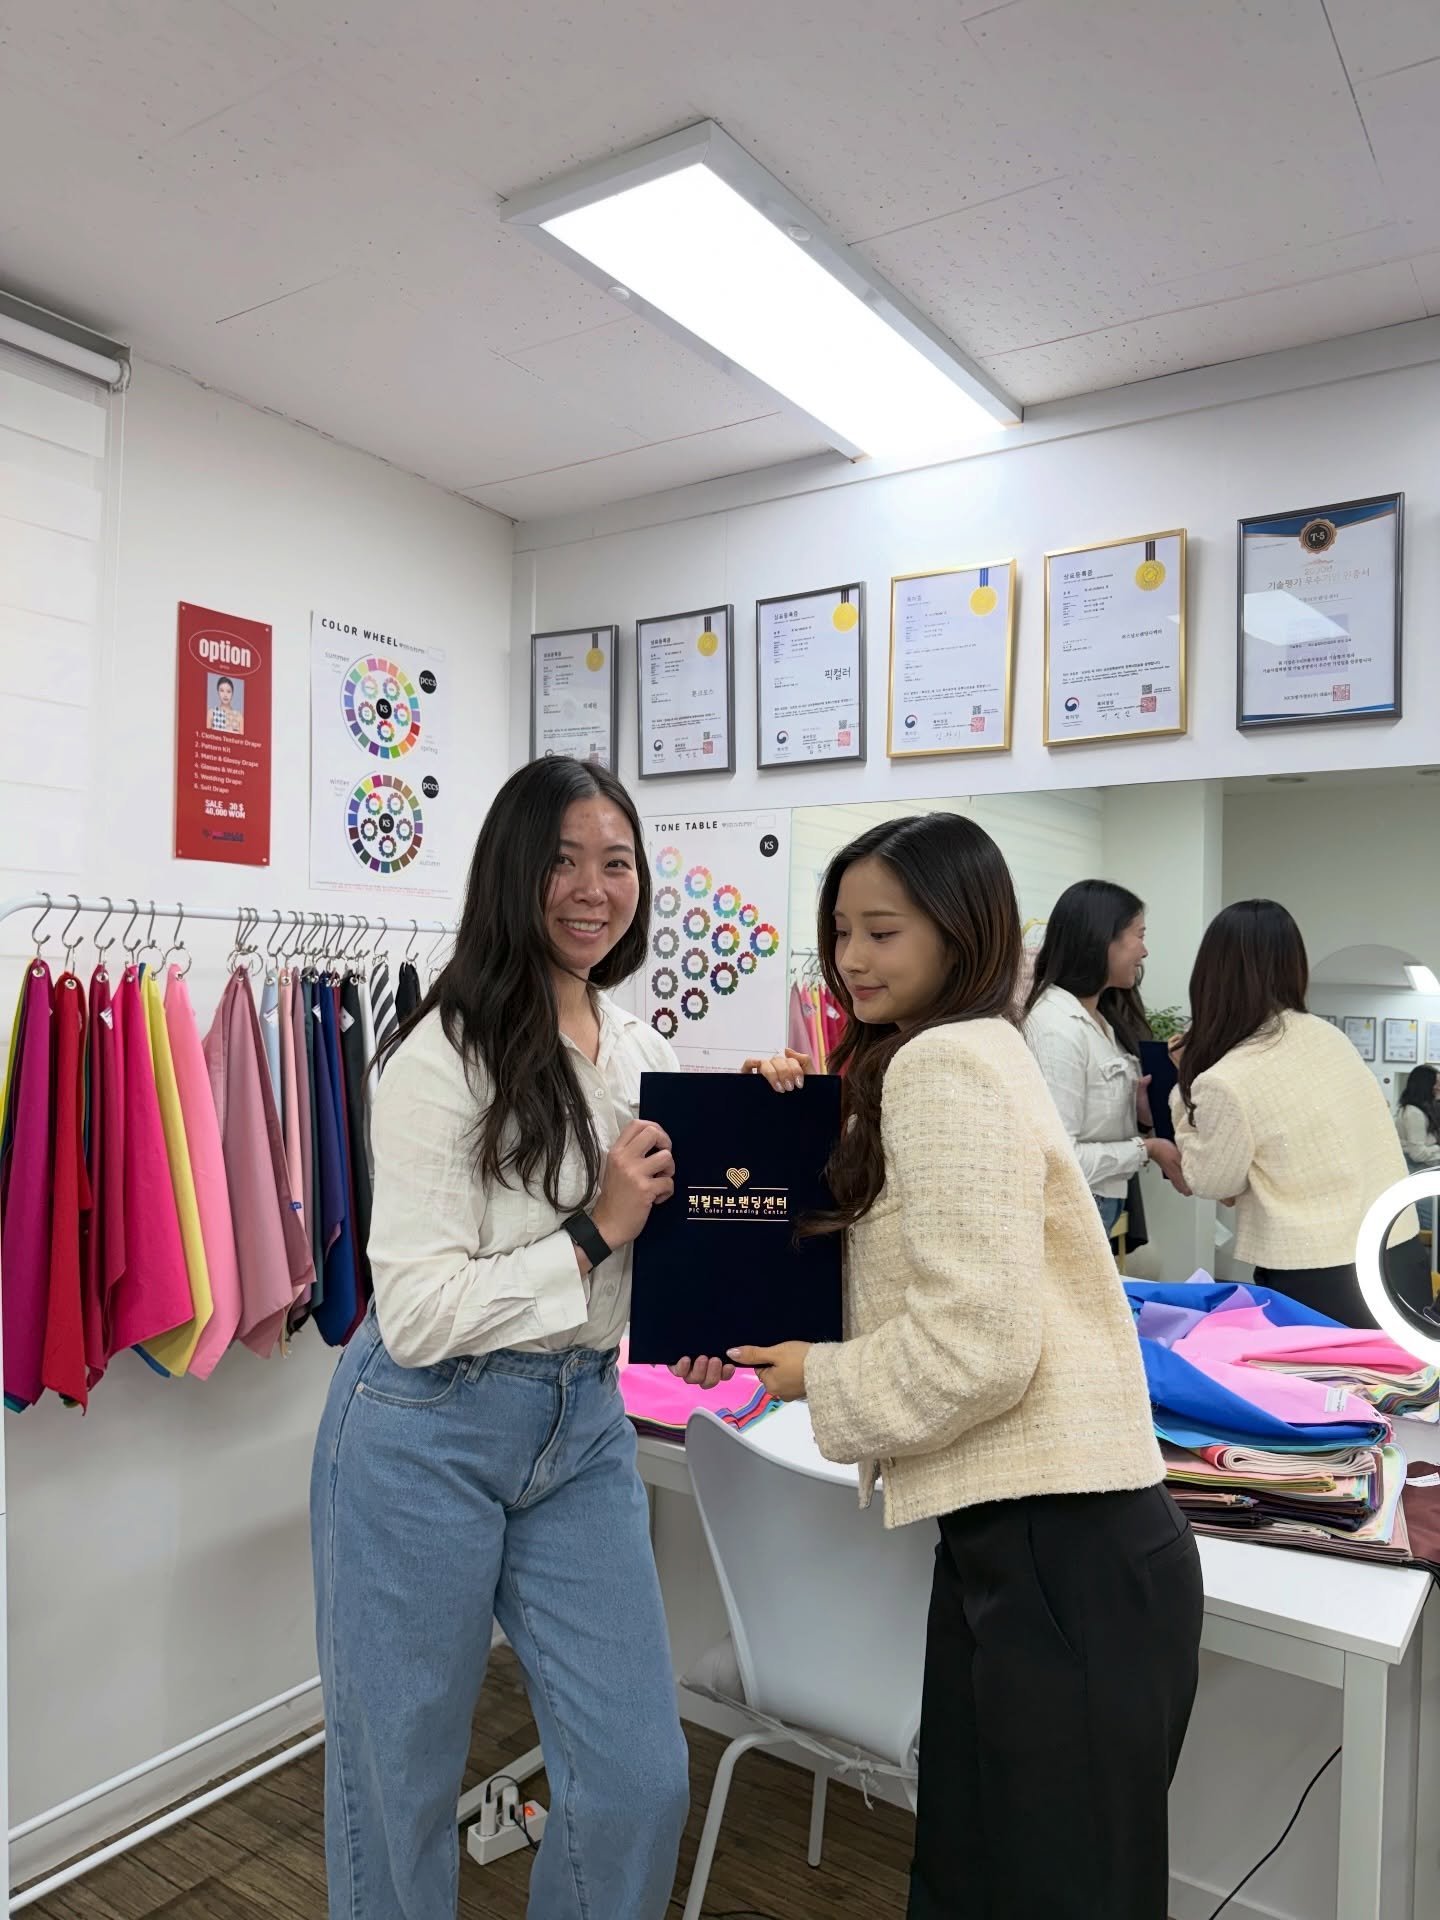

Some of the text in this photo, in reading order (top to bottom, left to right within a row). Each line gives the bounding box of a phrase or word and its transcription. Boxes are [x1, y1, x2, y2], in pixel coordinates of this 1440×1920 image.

[1310, 531, 1326, 542] T-5
[321, 618, 398, 647] COLOR WHEEL
[198, 638, 251, 668] option
[824, 666, 851, 681] 픽컬러
[380, 704, 389, 713] KS
[205, 799, 223, 809] SALE
[205, 807, 246, 820] 40,000 WON
[382, 819, 391, 828] KS
[655, 823, 681, 832] TONE
[685, 820, 718, 831] TABLE
[764, 841, 774, 850] KS
[688, 1194, 787, 1209] 픽컬러브랜딩센터
